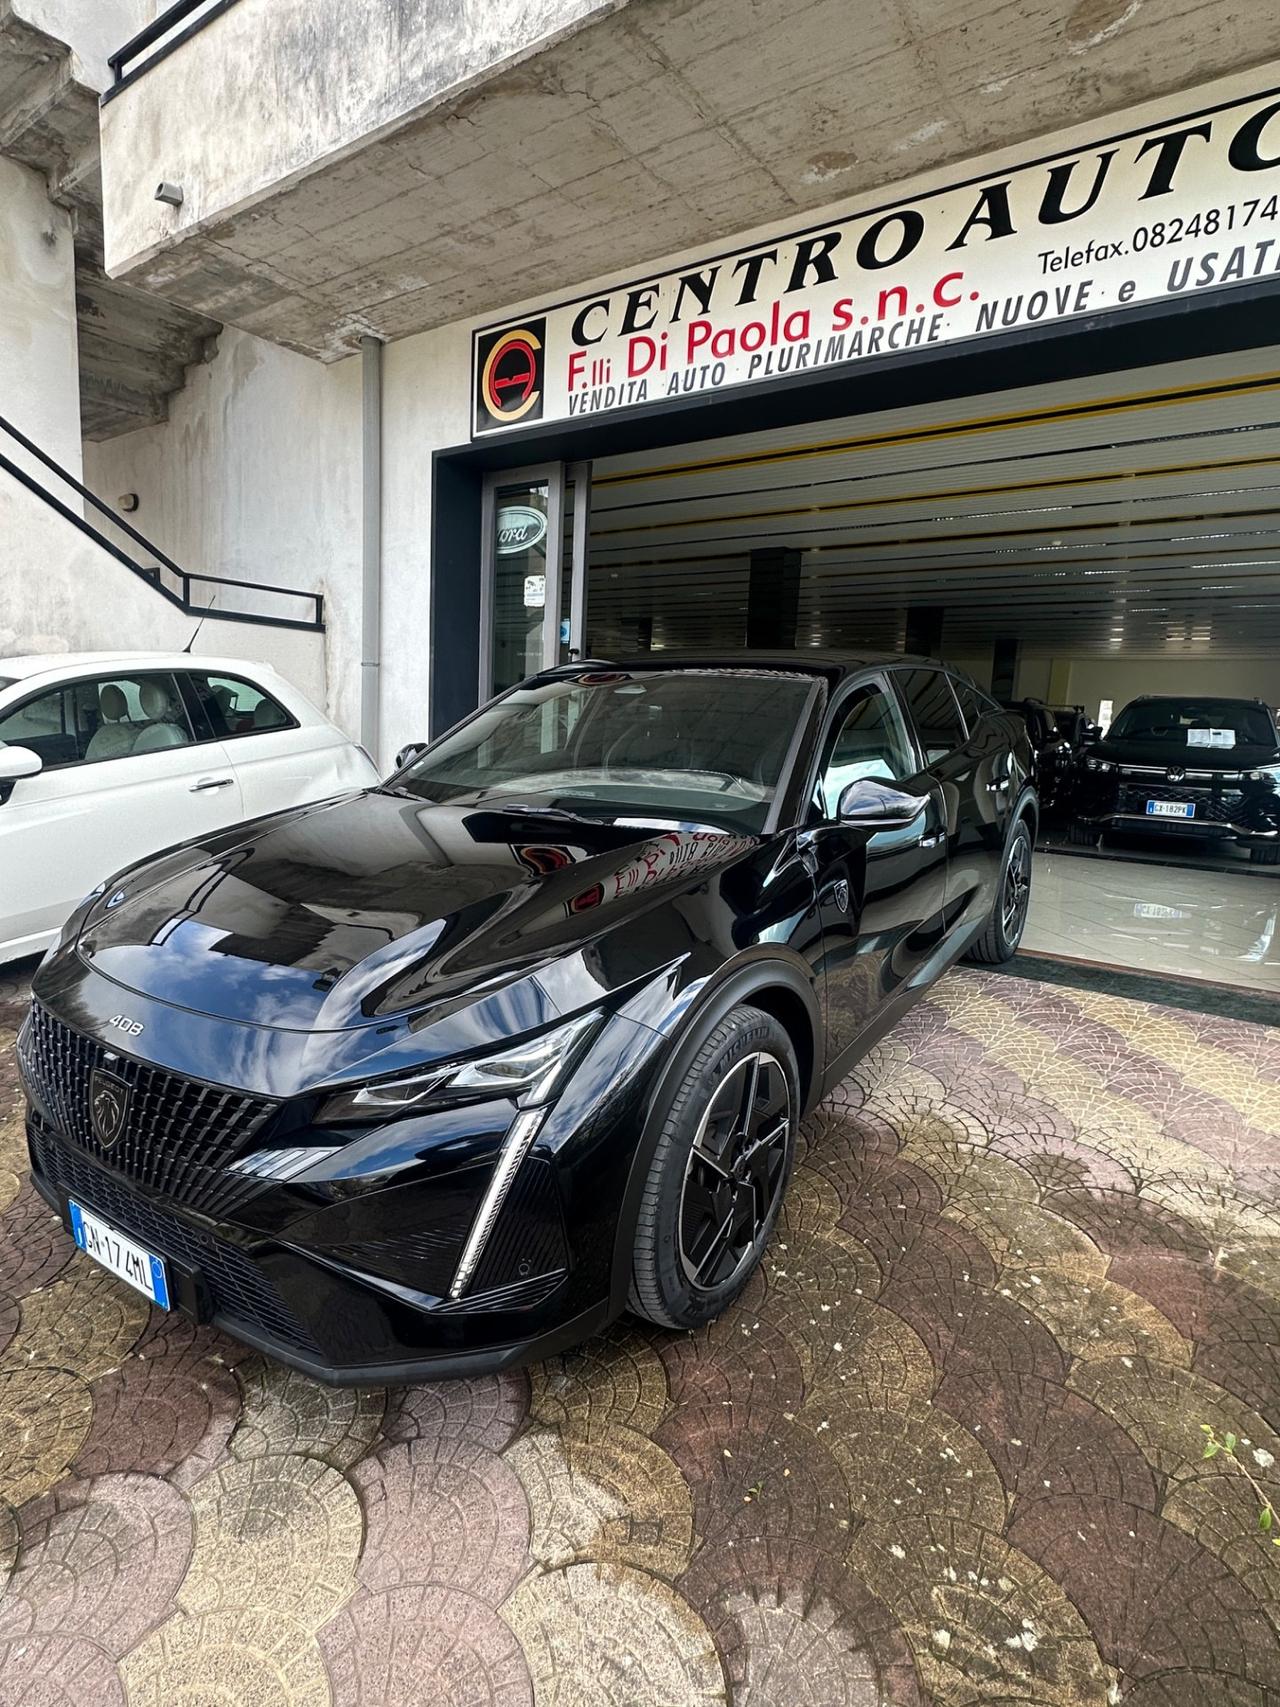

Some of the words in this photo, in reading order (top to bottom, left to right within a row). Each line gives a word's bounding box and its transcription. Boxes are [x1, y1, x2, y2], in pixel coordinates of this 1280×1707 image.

[571, 210, 925, 347] CENTRO
[944, 100, 1280, 252] AUTO
[568, 378, 648, 416] VENDITA
[667, 362, 726, 396] AUTO
[747, 312, 945, 379] PLURIMARCHE
[975, 280, 1094, 332] NUOVE
[1118, 280, 1136, 302] e
[1167, 239, 1280, 293] USAT
[568, 350, 612, 392] F.lli
[627, 331, 668, 378] Di
[687, 300, 811, 365] Paola
[832, 271, 980, 332] s.n.c.
[496, 526, 528, 543] ord
[109, 1014, 145, 1037] 408
